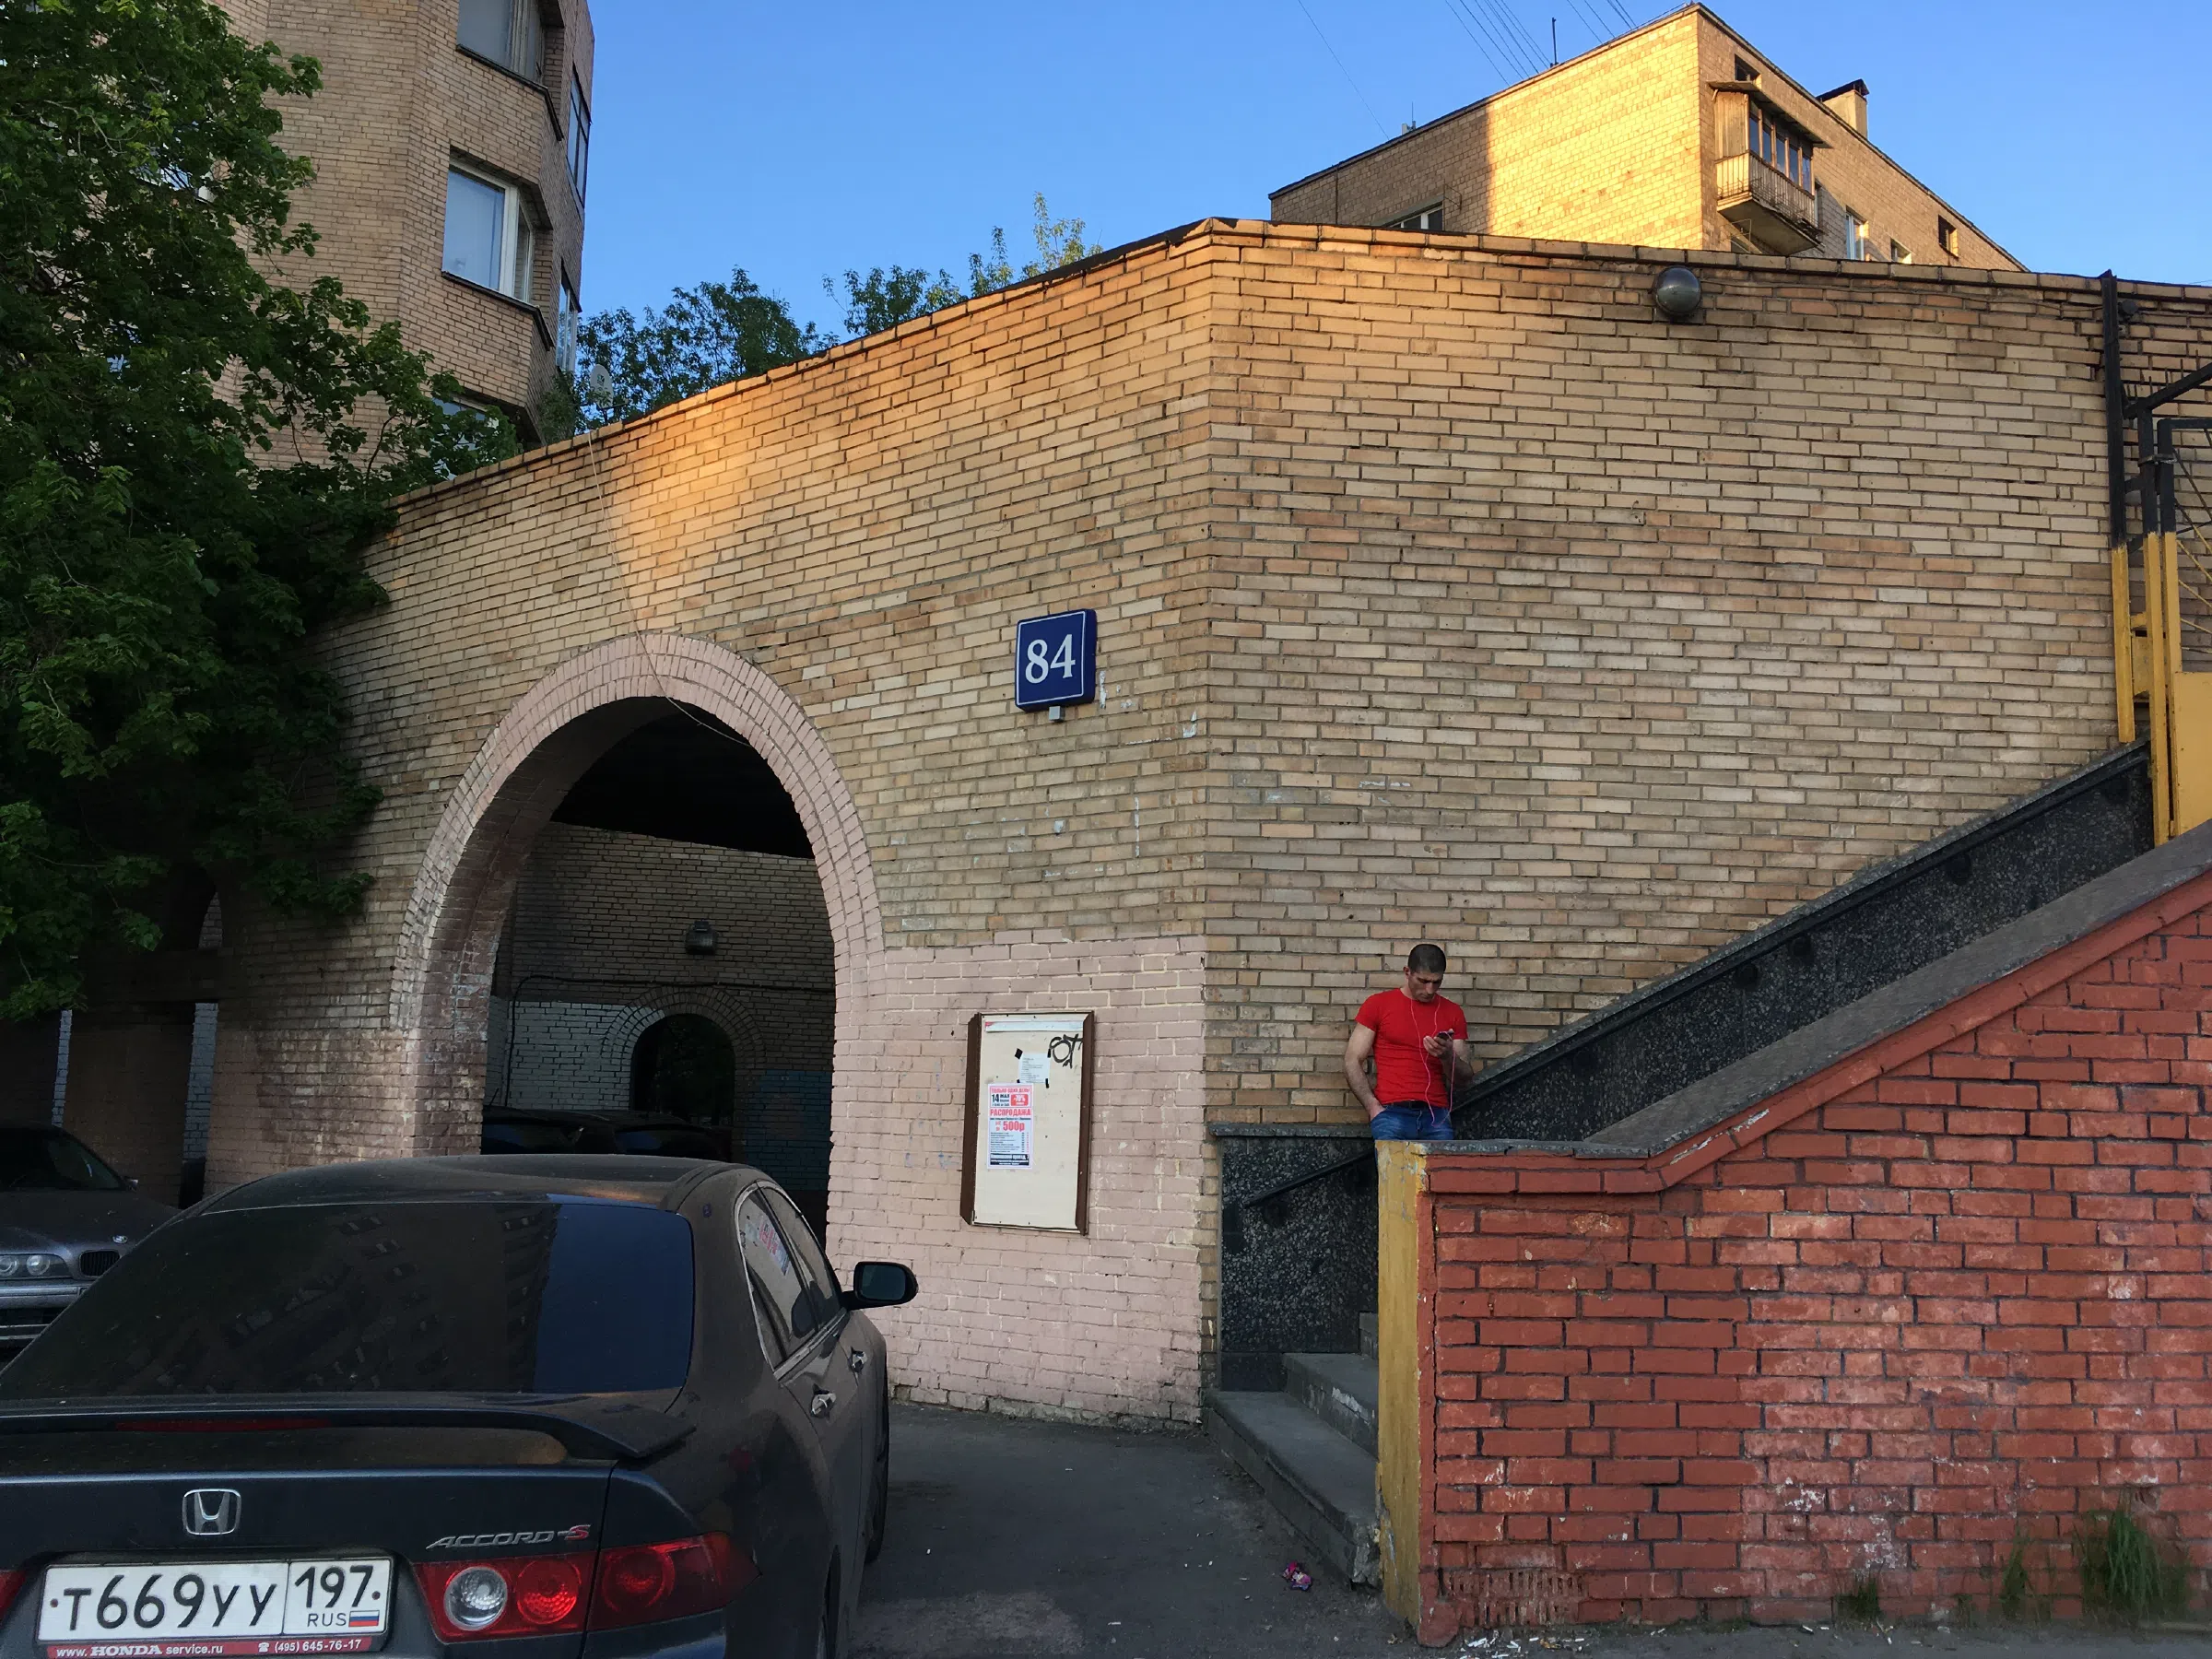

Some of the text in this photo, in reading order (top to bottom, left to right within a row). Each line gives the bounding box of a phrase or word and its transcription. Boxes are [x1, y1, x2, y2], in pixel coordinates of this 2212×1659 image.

[1025, 634, 1076, 683] 84
[992, 1093, 1000, 1103] 14
[990, 1109, 1031, 1117] РАСПРОДАЖА
[1003, 1120, 1025, 1132] 500р
[426, 1530, 554, 1550] ACCORD
[294, 1564, 374, 1608] 197
[306, 1612, 347, 1628] RUS
[56, 1639, 362, 1657] www. HONDA service.ru (495) 645-76-17
